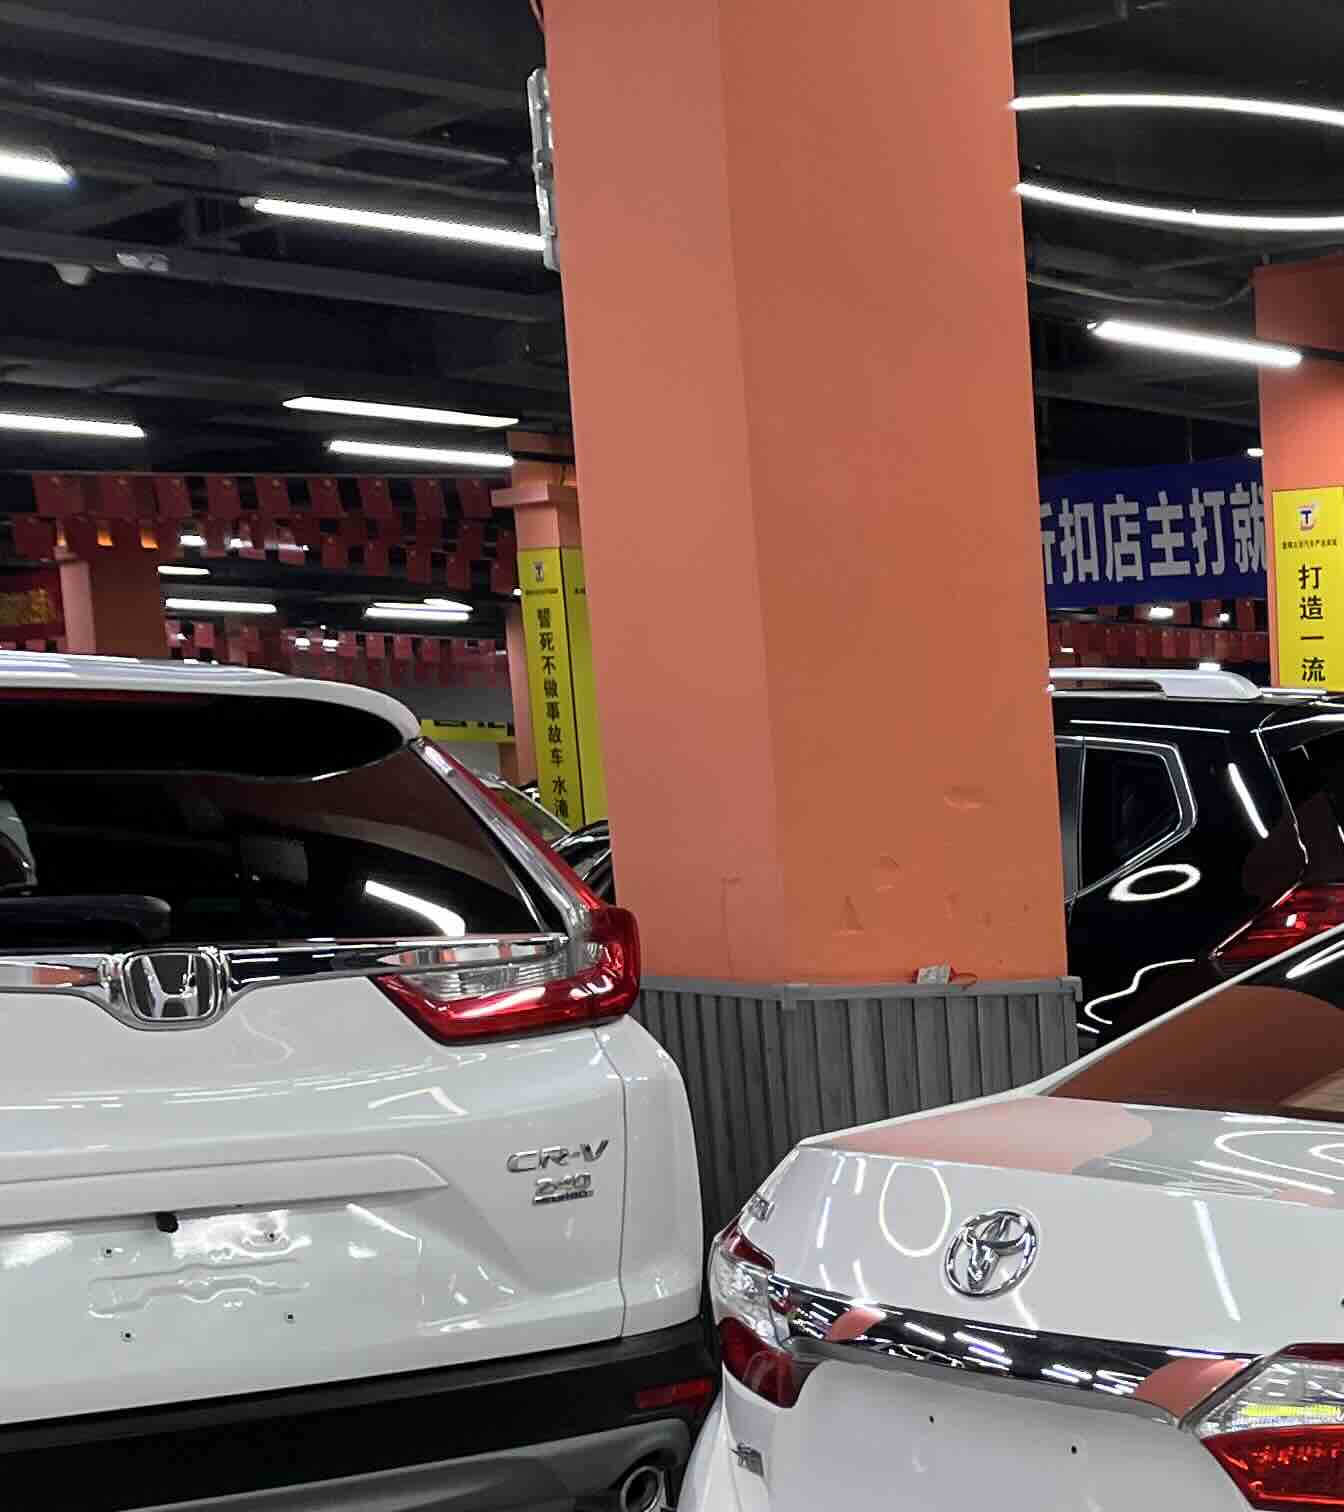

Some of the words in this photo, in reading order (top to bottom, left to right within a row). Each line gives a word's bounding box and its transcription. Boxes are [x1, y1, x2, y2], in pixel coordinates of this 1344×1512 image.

[1299, 563, 1326, 688] 打造一流
[506, 1138, 609, 1173] CR-V
